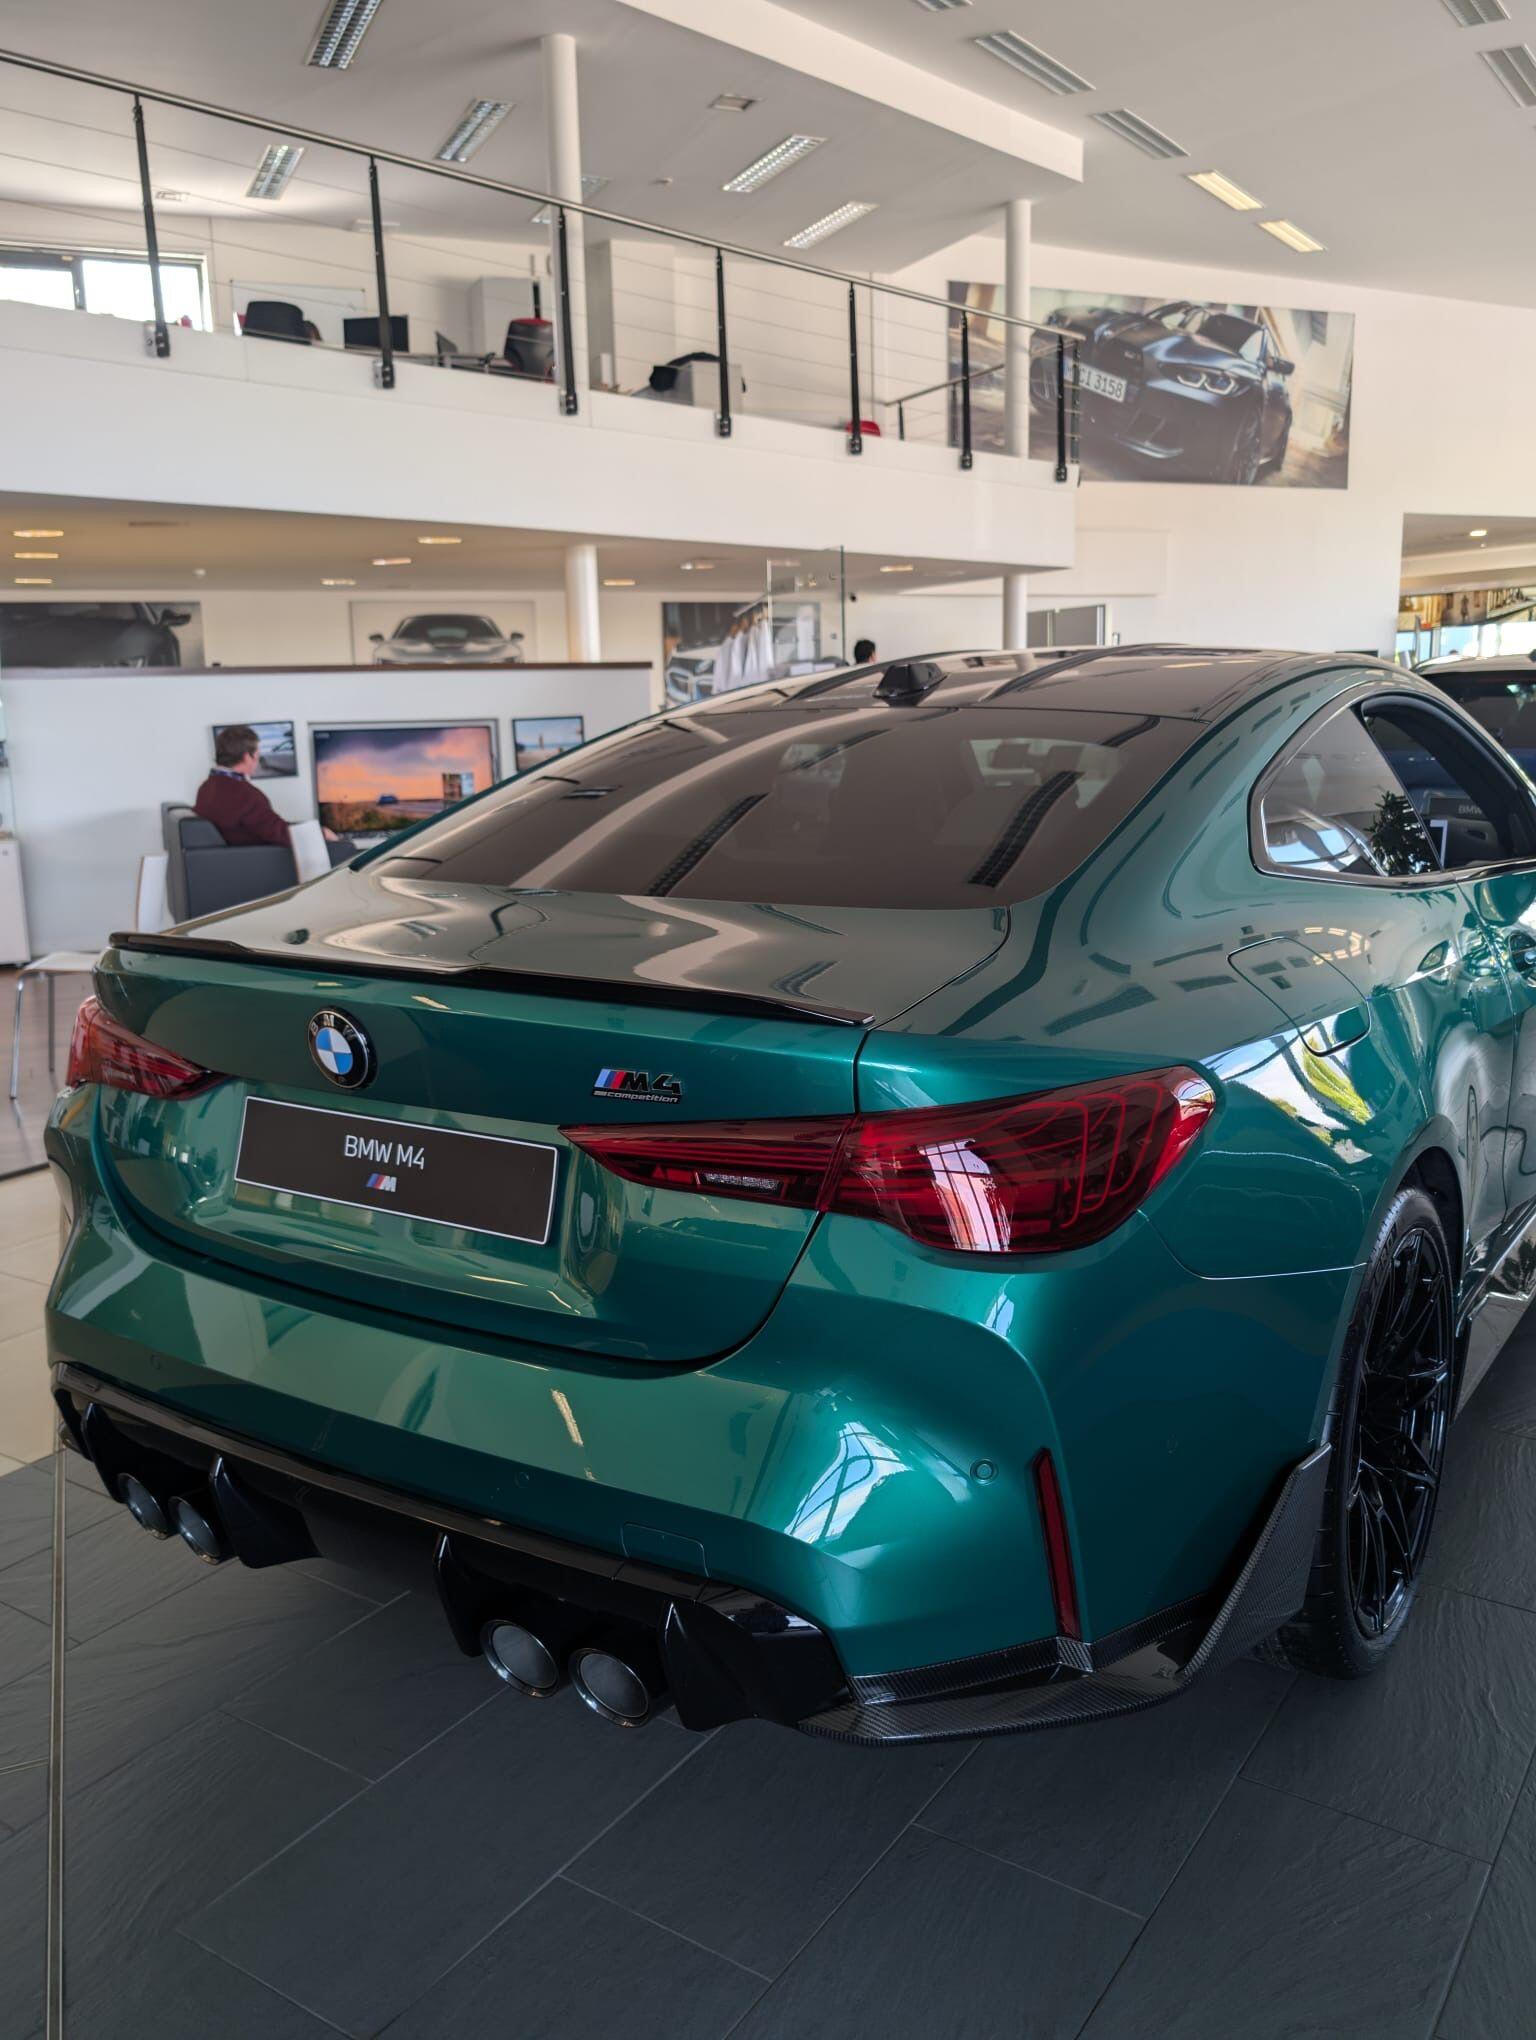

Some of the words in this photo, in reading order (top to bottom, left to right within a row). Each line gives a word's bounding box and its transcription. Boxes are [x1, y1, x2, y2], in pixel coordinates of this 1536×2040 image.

[1094, 374, 1123, 399] 3158
[617, 1069, 682, 1095] M4
[606, 1091, 679, 1103] competition
[344, 1134, 393, 1164] BMW
[396, 1143, 425, 1170] M4
